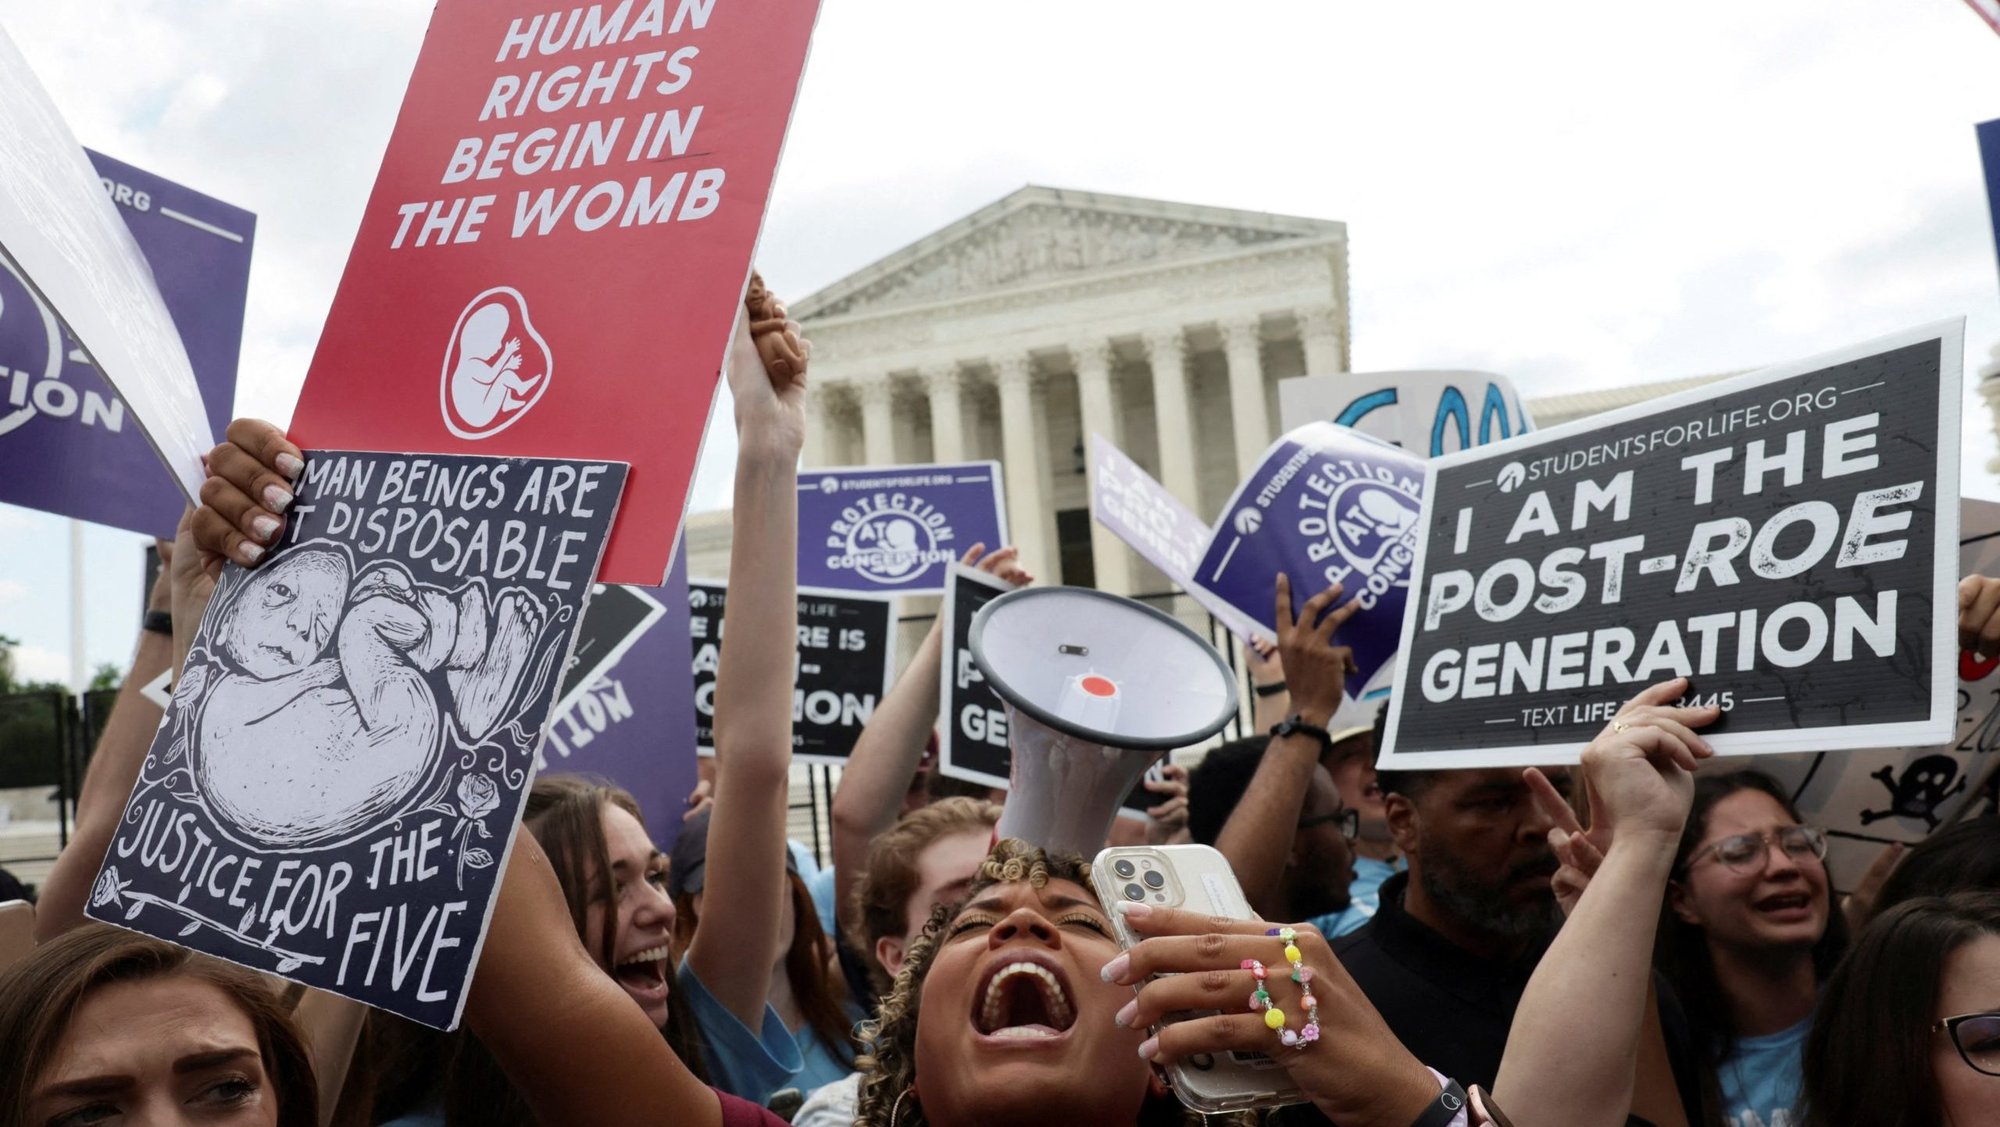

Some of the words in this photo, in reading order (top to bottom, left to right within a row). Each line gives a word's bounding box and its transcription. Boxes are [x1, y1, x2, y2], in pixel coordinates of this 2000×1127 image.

[495, 0, 716, 62] HUMAN
[479, 46, 700, 121] RIGHTS
[441, 117, 624, 184] BEGIN
[627, 106, 704, 161] IN
[390, 194, 496, 249] THE
[511, 167, 725, 238] WOMB
[1529, 387, 1837, 481] STUDENTSFORLIFE.ORG
[291, 456, 376, 500] MAN
[377, 459, 509, 511] BEINGS
[514, 464, 608, 518] ARE
[827, 493, 954, 548] PROTECTION
[1298, 460, 1420, 584] PROTECTION
[1454, 507, 1473, 554] I
[1505, 471, 1633, 543] AM
[1681, 412, 1879, 505] THE
[327, 501, 588, 590] DISPOSABLE
[860, 521, 887, 541] AT
[1339, 505, 1375, 546] AT
[1423, 480, 1924, 631] POST-ROE
[838, 629, 866, 651] IS
[1421, 590, 1897, 702] GENERATION
[1522, 706, 1568, 727] TEXT
[1573, 701, 1616, 723] LIFE
[118, 799, 262, 908] JUSTICE
[260, 860, 353, 939] FOR
[367, 818, 442, 889] THE
[336, 901, 468, 1002] FIVE
